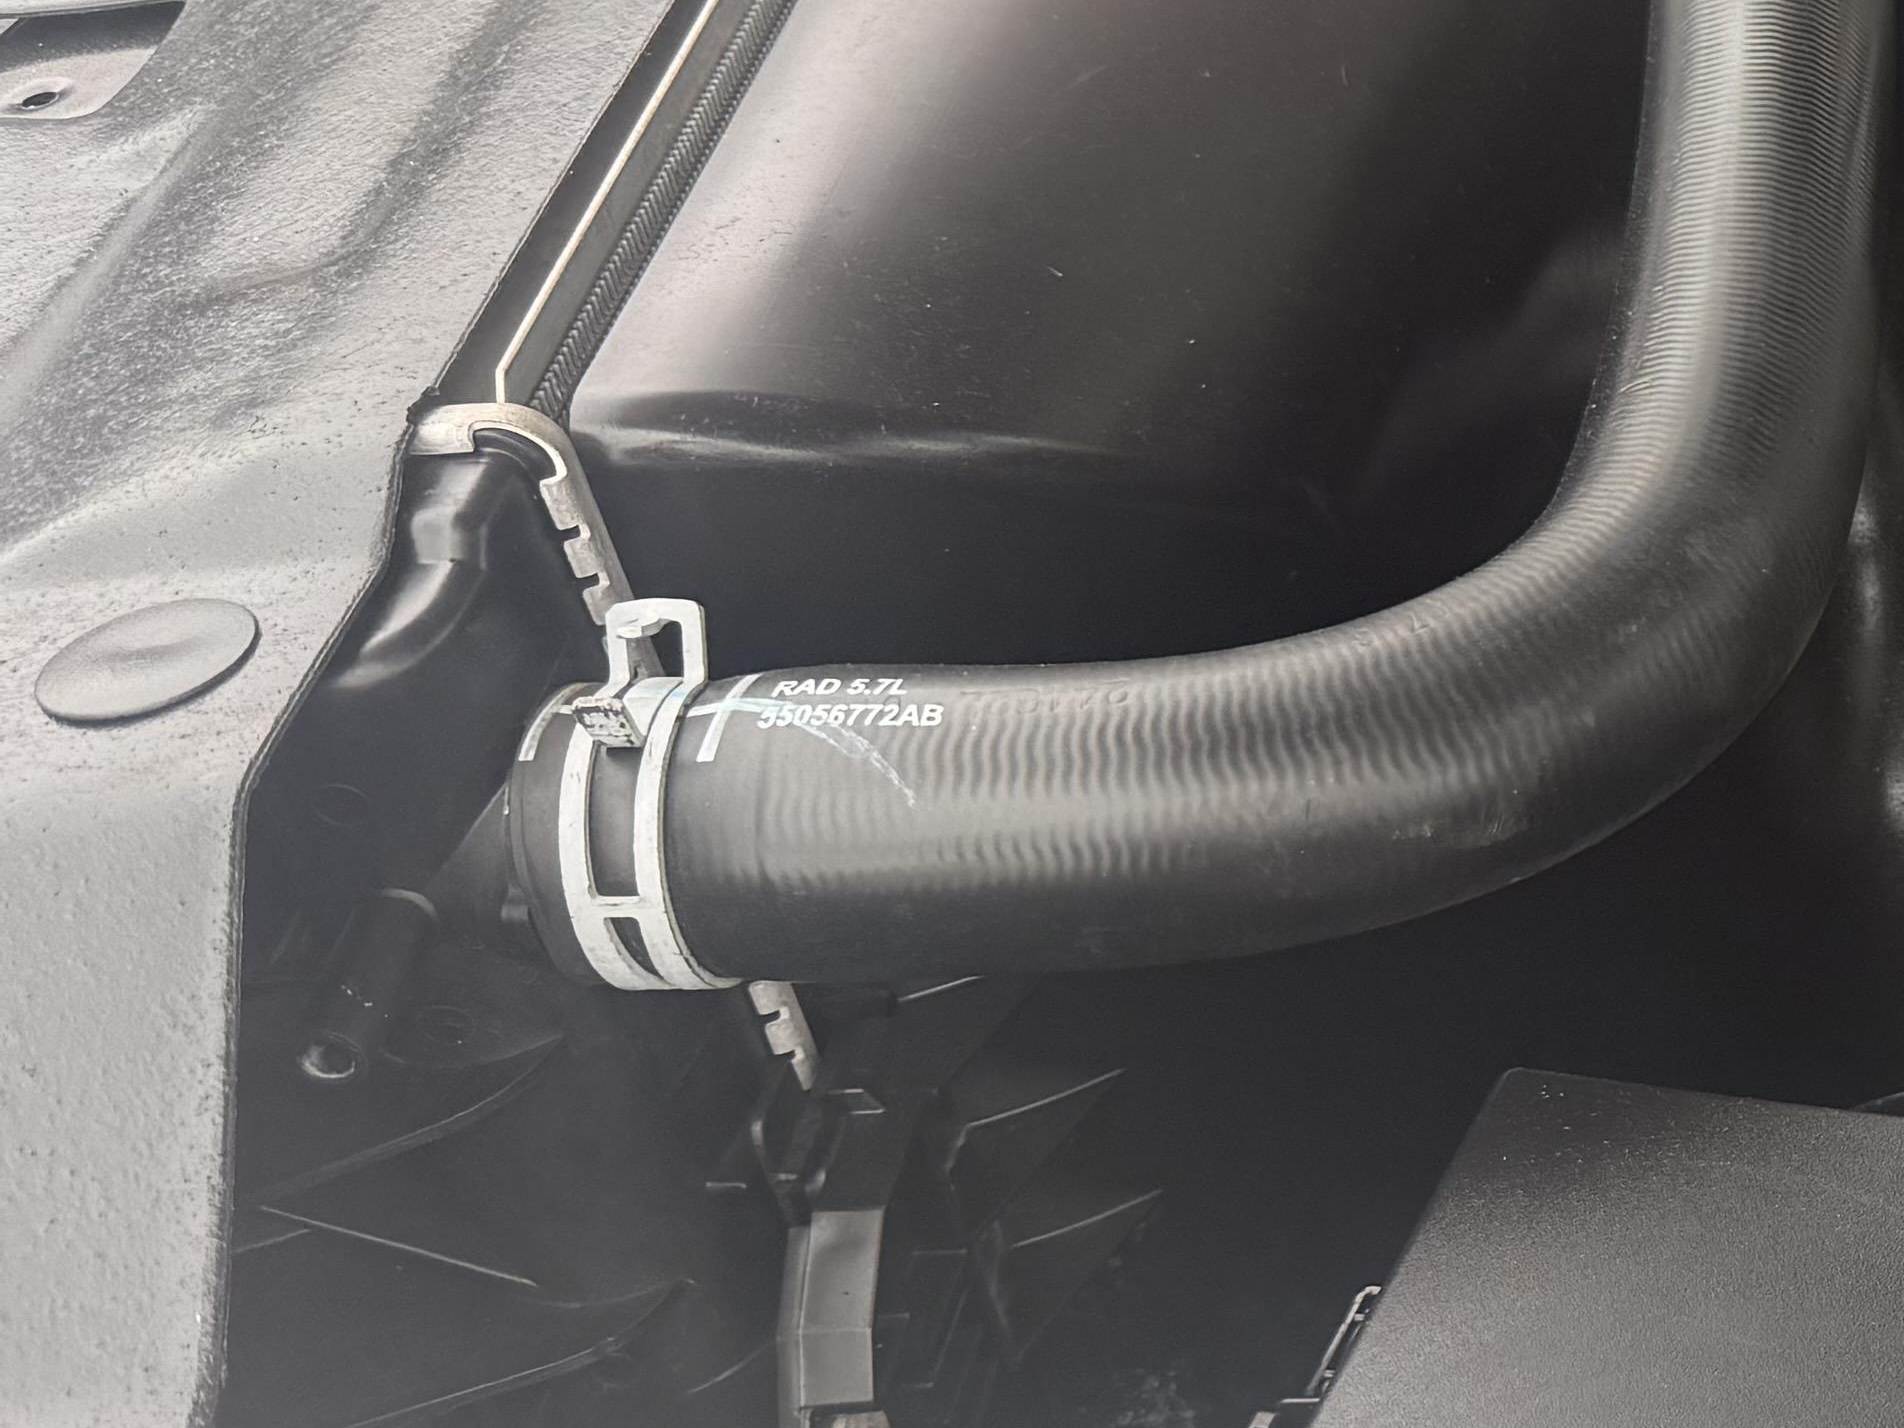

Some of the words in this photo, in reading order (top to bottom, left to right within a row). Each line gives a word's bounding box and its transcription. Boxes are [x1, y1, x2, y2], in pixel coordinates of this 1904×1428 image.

[772, 677, 842, 697] RAD
[846, 677, 908, 696] 5.7L
[756, 703, 945, 729] 55056772AB
